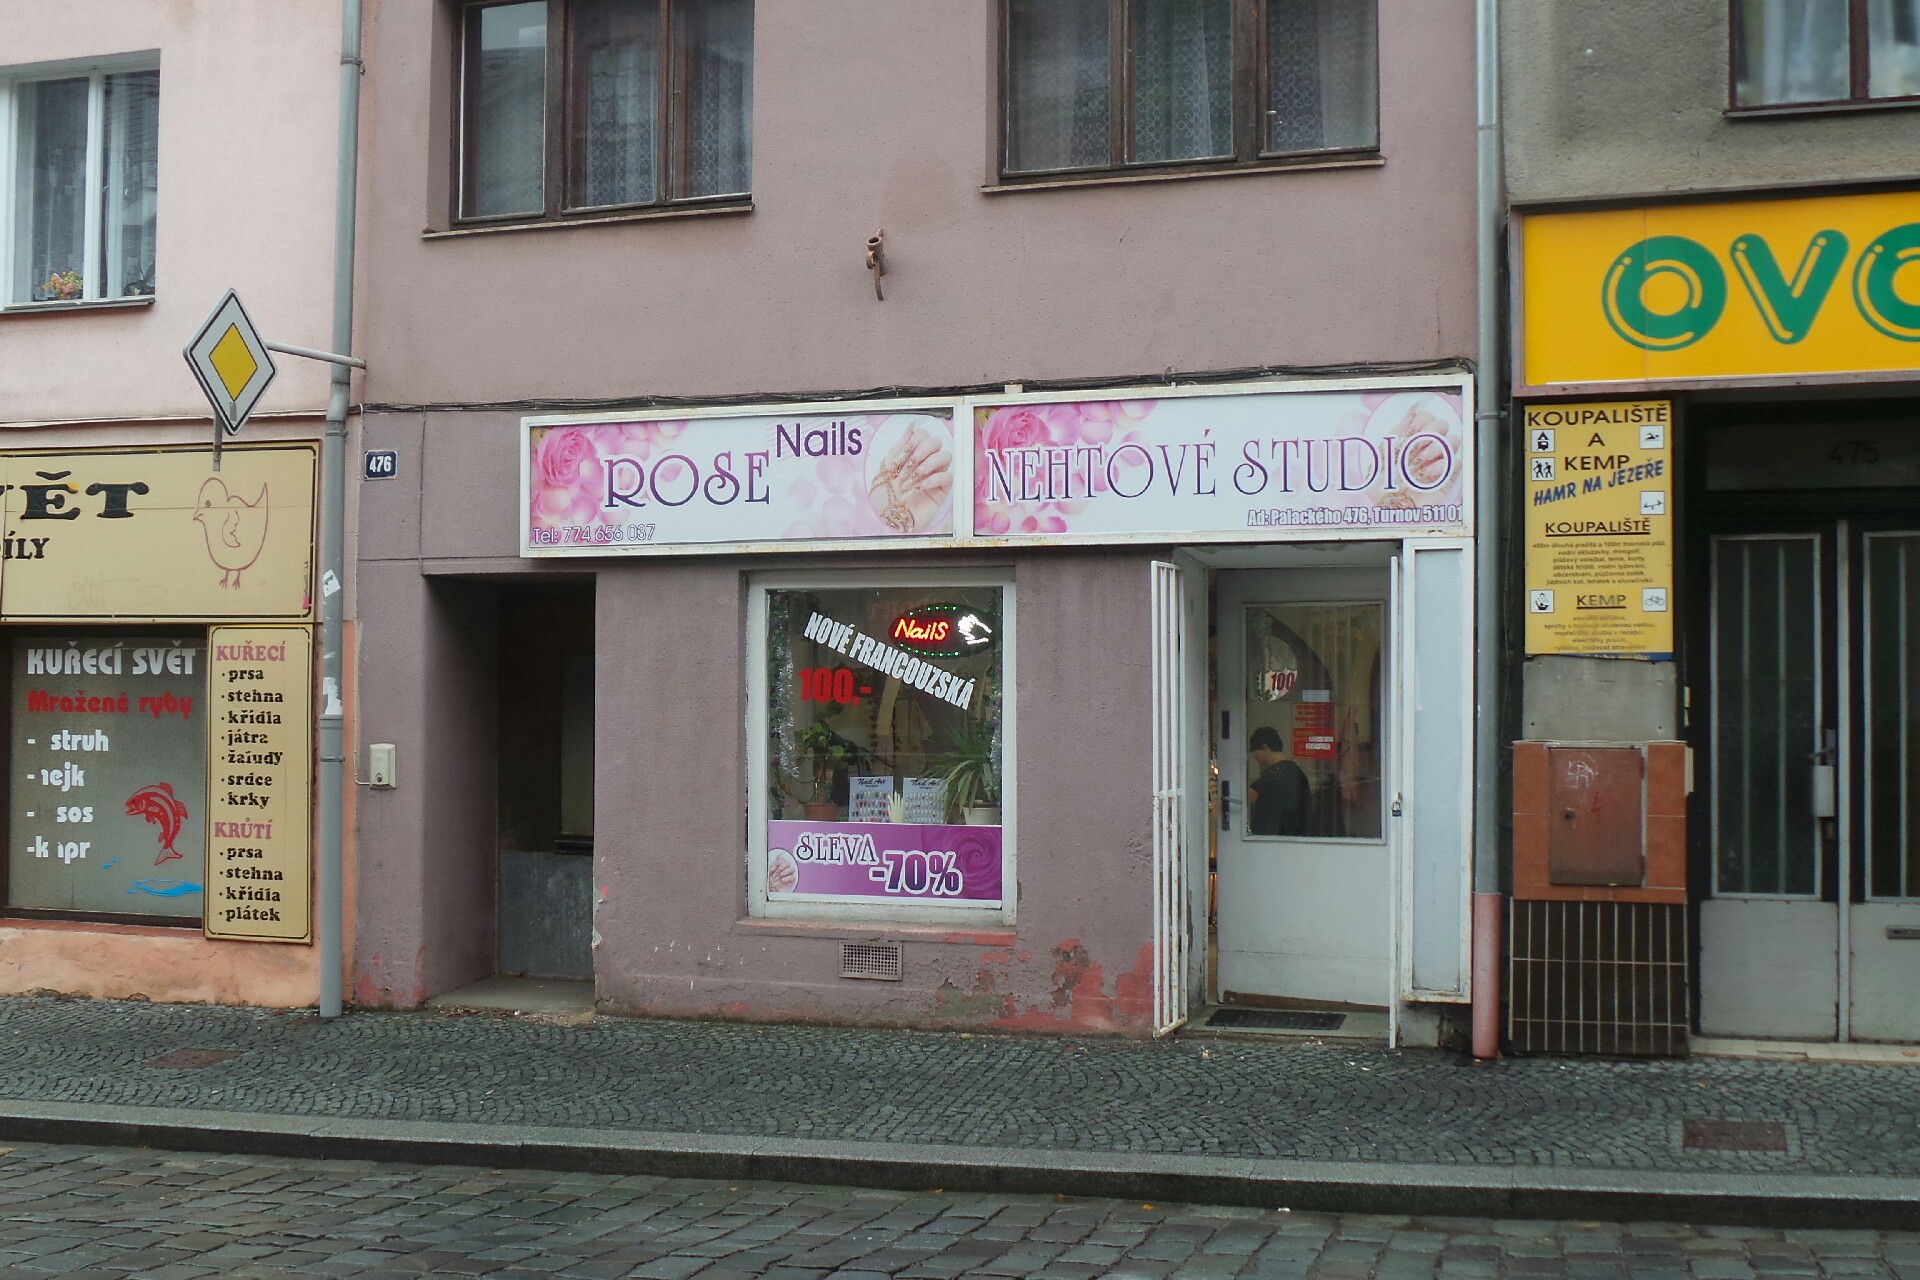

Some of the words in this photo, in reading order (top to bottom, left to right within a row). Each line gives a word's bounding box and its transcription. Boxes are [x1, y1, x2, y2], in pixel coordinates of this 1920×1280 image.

[1528, 403, 1668, 427] KOUPALIŠTĚ
[776, 422, 863, 458] Nails
[1588, 432, 1605, 447] A
[1829, 440, 1879, 464] 475
[369, 456, 392, 472] 476
[987, 428, 1217, 502] NEHTOVÉ
[1233, 433, 1453, 495] STUDIO
[1564, 455, 1630, 470] KEMP
[604, 449, 771, 508] ROSE
[1534, 482, 1577, 506] HAMR
[1583, 475, 1602, 494] NA
[1608, 457, 1664, 488] JEZEŘE
[0, 470, 149, 520] ĚT
[1248, 509, 1269, 526] Ad:
[1270, 507, 1341, 526] Palackého
[1344, 507, 1371, 525] 476,
[1373, 506, 1421, 524] Turnov
[1423, 505, 1446, 522] 511
[1545, 517, 1651, 534] KOUPALIŠTĚ
[533, 527, 558, 544] Tel:
[563, 526, 591, 542] 774
[595, 525, 623, 542] 656
[627, 524, 656, 540] 037
[1576, 594, 1626, 606] KEMP
[27, 640, 123, 675] KUŘECÍ
[132, 640, 196, 675] SVĚT
[215, 640, 286, 661] KUŘECÍ
[803, 611, 853, 651] NOVÉ
[849, 632, 976, 710] FRANCOUZSKÁ
[228, 669, 264, 682] prsa
[227, 689, 283, 703] stehna
[797, 667, 872, 707] 100,-
[27, 689, 129, 713] Mražené
[138, 690, 192, 720] ryby
[227, 709, 282, 724] křídla
[51, 729, 109, 751] struh
[228, 729, 268, 746] játra
[227, 750, 283, 765] žaludy
[227, 773, 272, 786] srdce
[227, 792, 270, 809] krky
[56, 806, 94, 823] sos
[214, 817, 273, 840] KRŮTÍ
[226, 847, 263, 860] prsa
[796, 834, 877, 863] SLEVA
[226, 866, 284, 880] stehna
[871, 852, 961, 893] -70%
[226, 886, 281, 902] křídla
[225, 905, 281, 922] plátek
